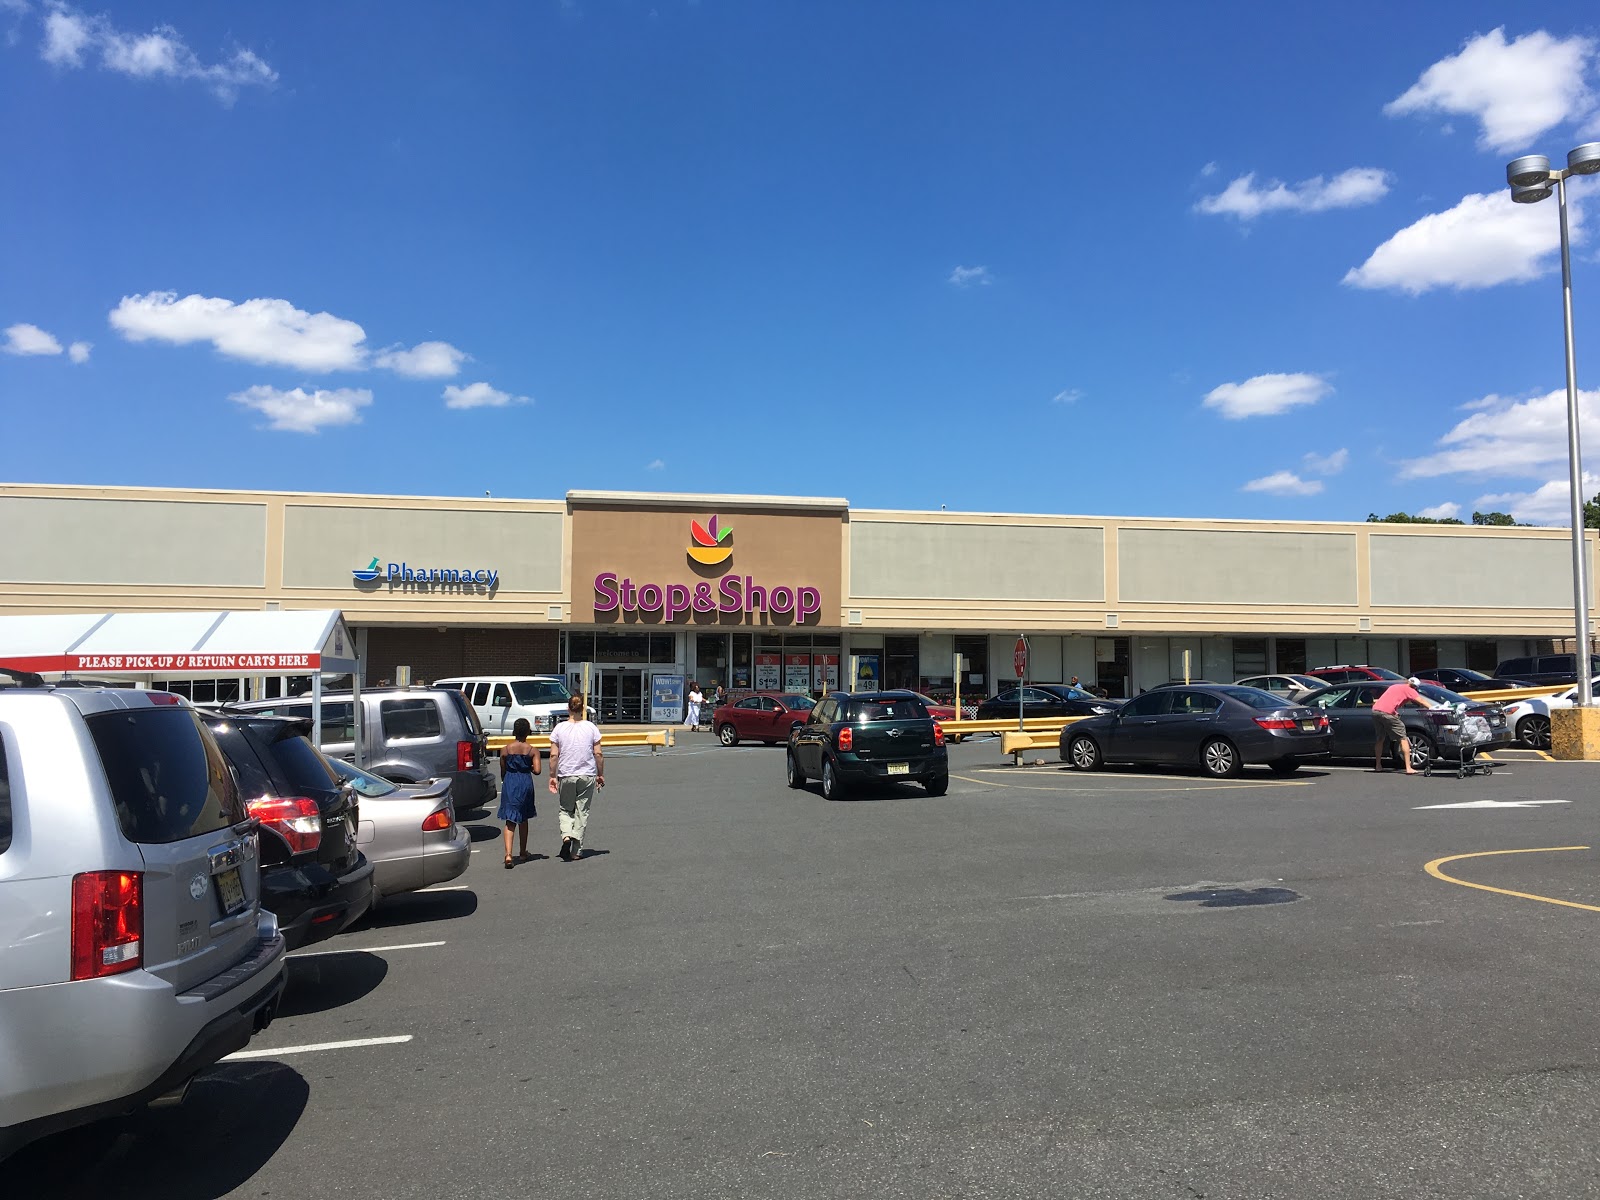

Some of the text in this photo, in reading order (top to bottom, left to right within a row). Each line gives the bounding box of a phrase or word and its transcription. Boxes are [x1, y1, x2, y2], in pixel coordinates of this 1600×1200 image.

[387, 562, 498, 588] Pharmacy
[594, 572, 821, 623] Stop&Shop
[78, 654, 309, 668] PLEASE PICK-UP & RETURN CARTS HERE
[597, 649, 640, 657] welcome to
